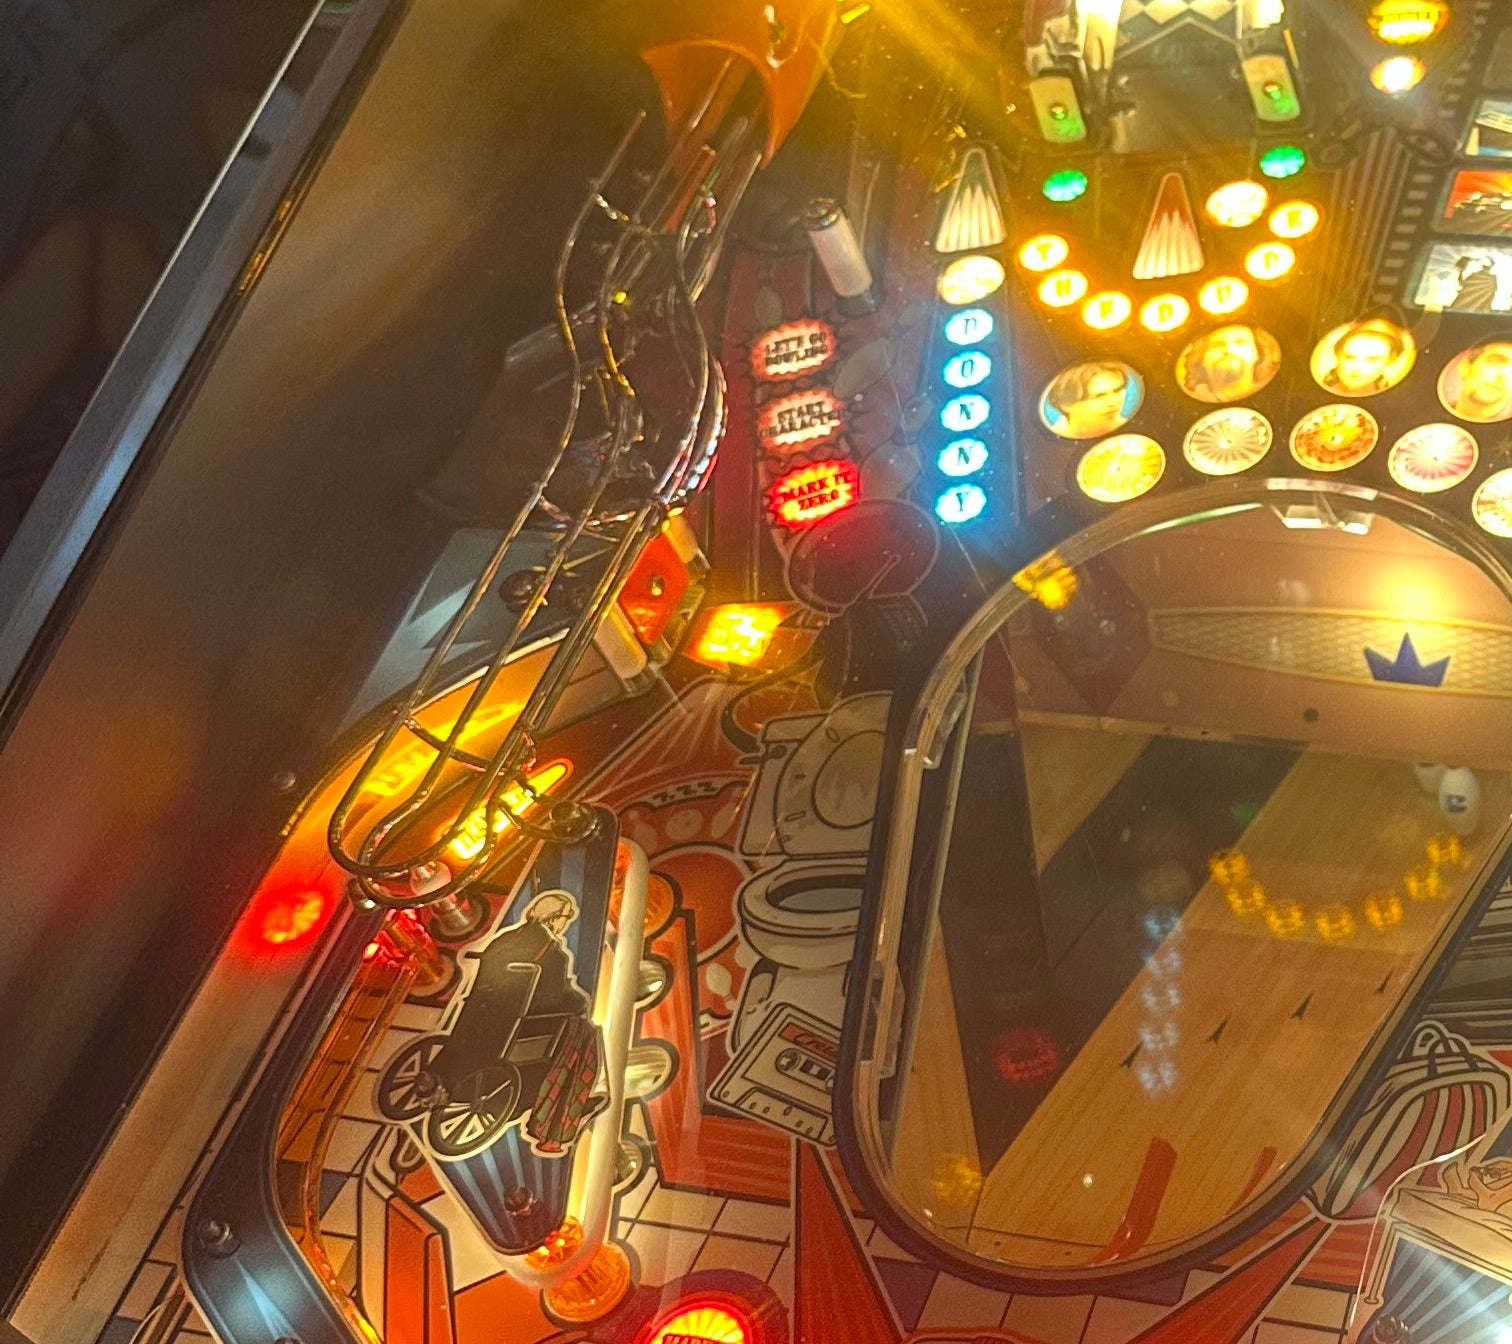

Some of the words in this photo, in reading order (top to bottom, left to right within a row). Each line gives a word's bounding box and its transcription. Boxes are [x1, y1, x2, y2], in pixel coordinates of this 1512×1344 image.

[777, 401, 825, 424] START
[781, 477, 830, 502] MARK
[834, 471, 851, 486] IT
[797, 489, 840, 511] ZERO
